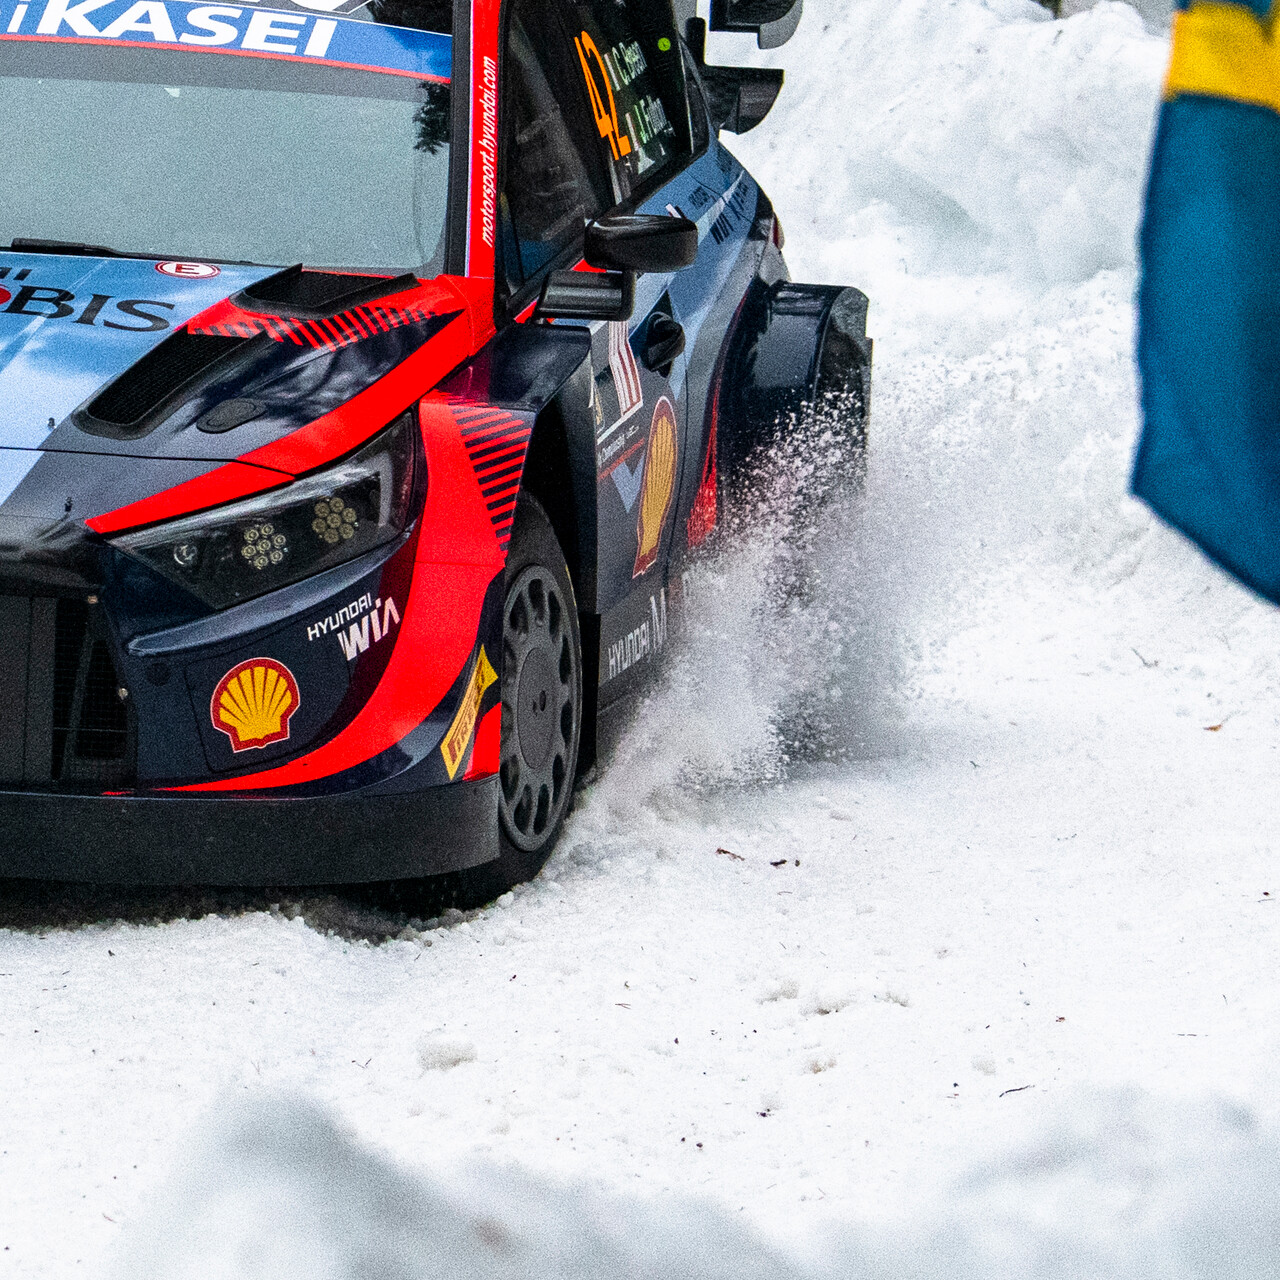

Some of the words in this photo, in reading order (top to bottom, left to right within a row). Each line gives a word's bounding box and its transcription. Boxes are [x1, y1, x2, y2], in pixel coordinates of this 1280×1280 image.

[573, 30, 632, 161] 42
[478, 55, 498, 249] motorsport.hyundai.com
[306, 592, 372, 641] HYUNDAI
[607, 620, 650, 680] HYUNDAI
